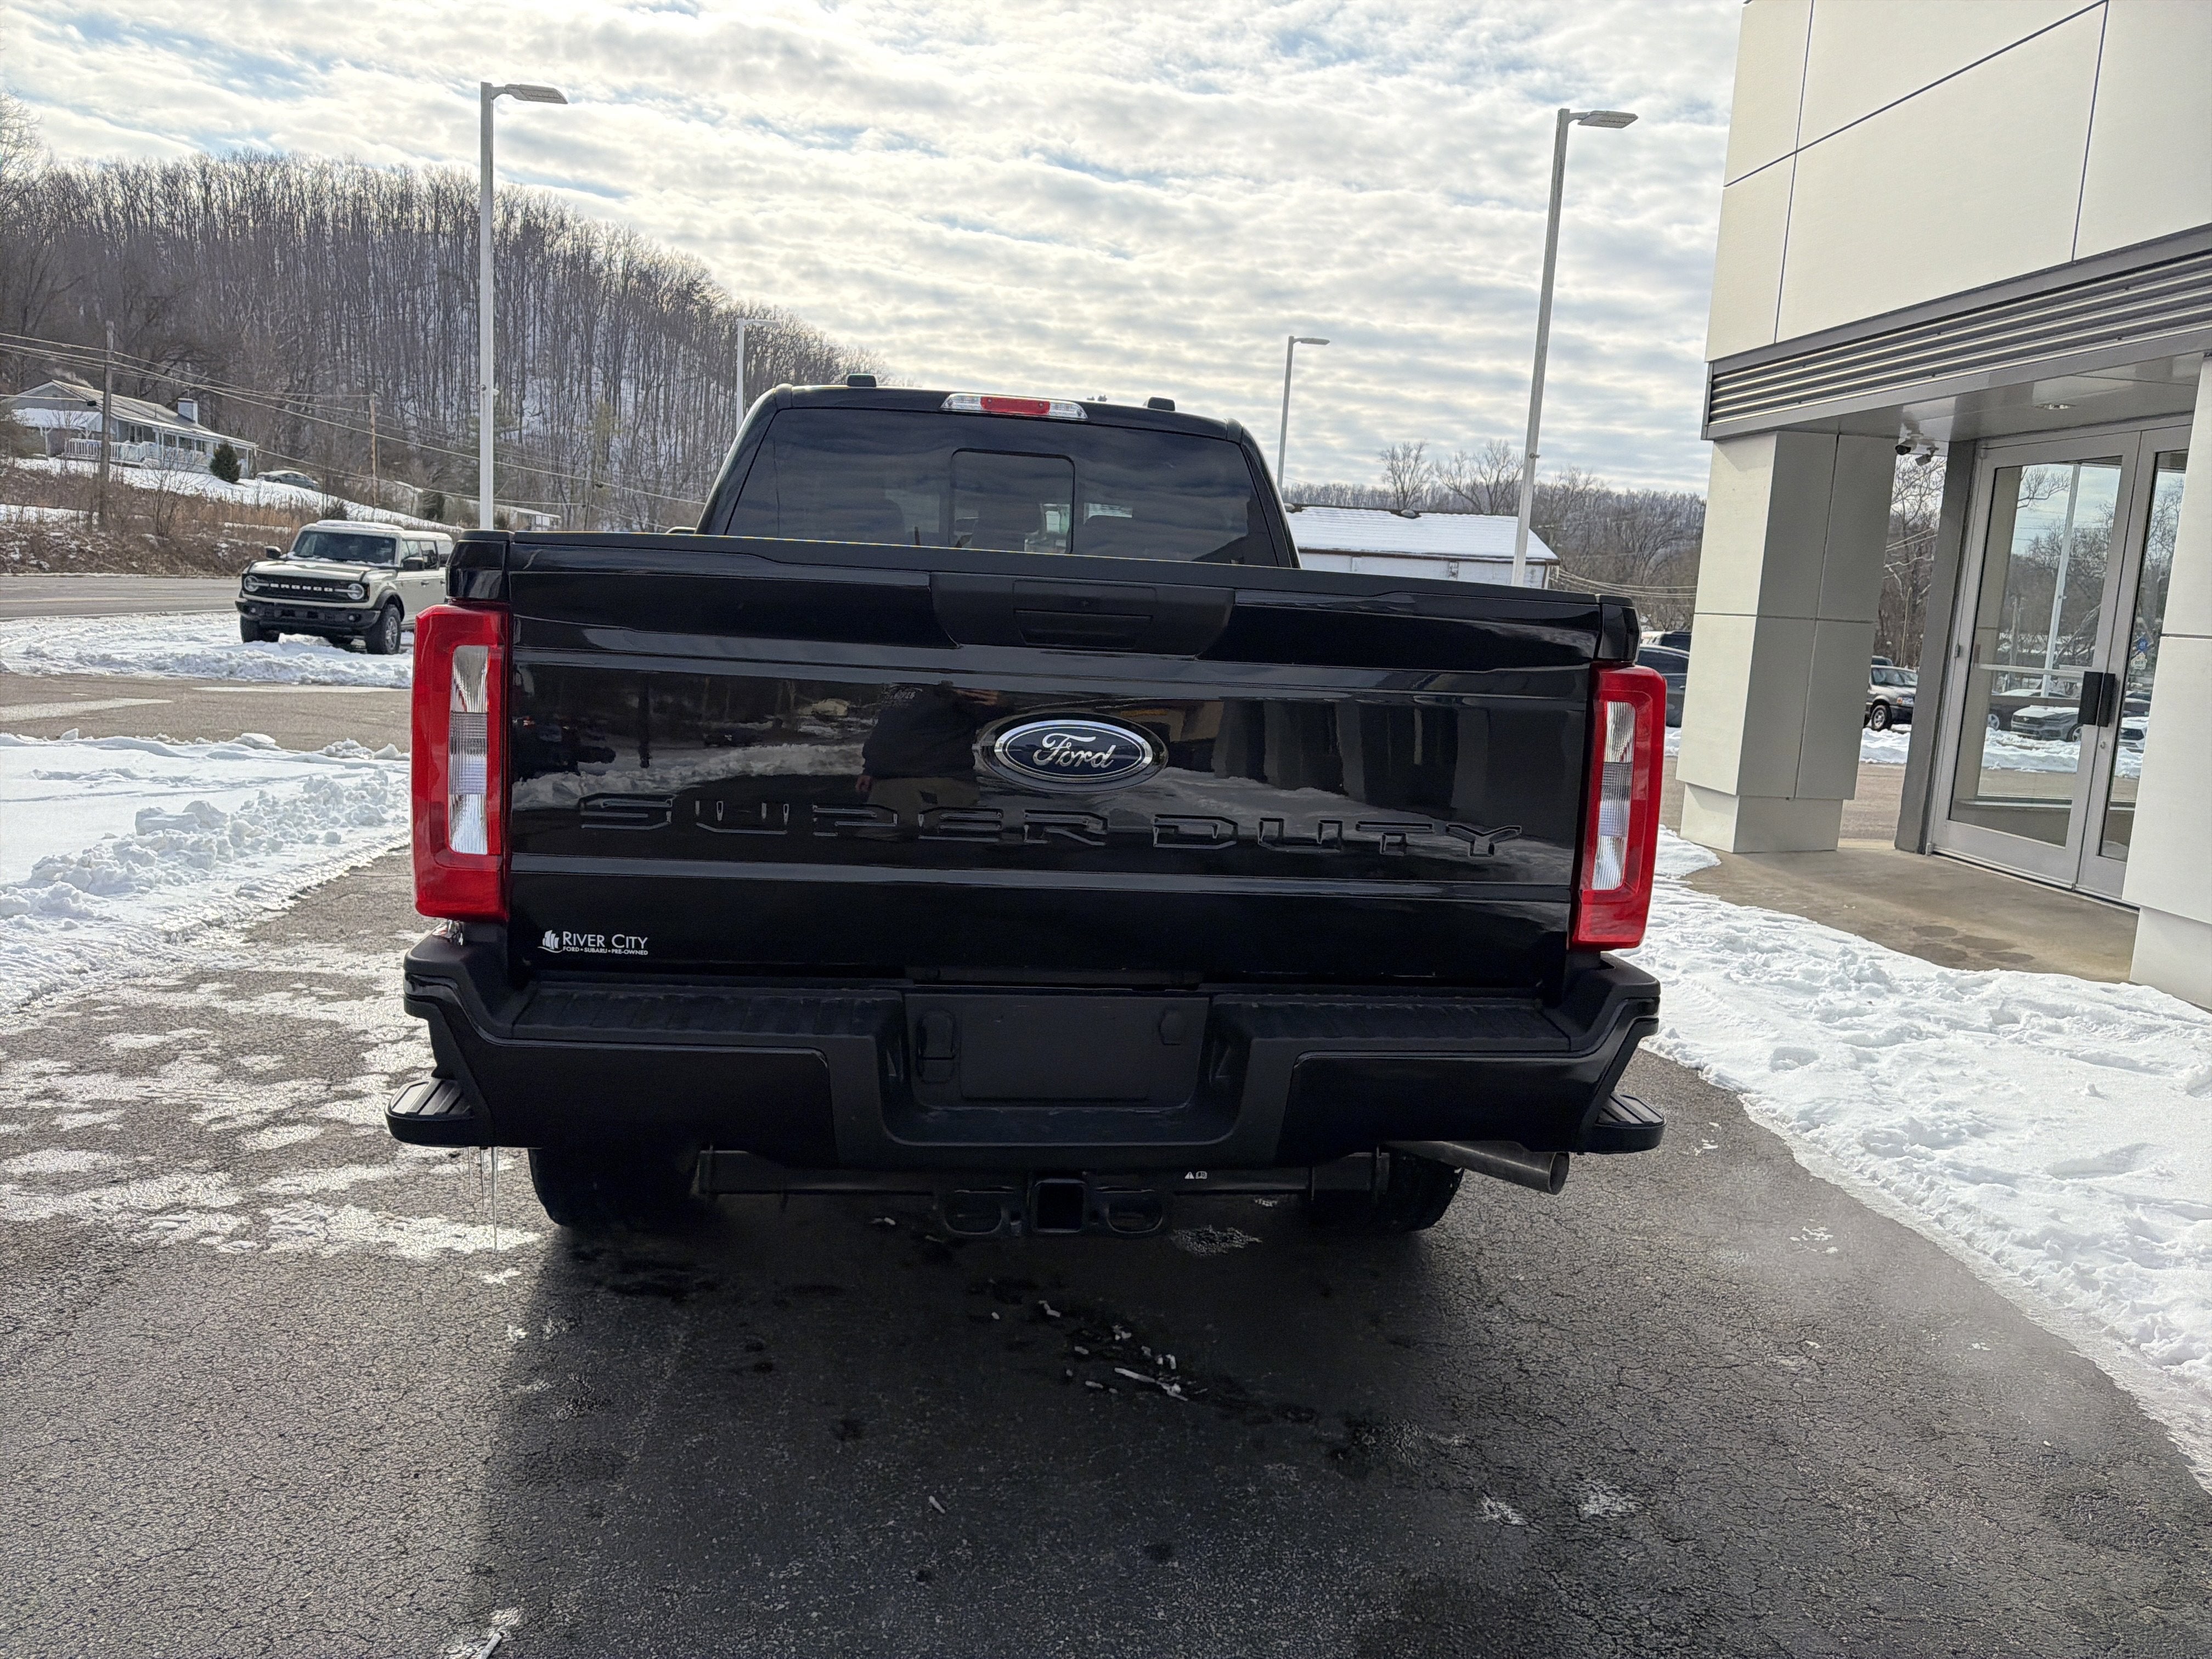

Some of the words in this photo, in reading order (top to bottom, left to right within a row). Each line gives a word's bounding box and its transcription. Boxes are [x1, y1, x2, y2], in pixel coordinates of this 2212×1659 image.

[270, 583, 333, 592] BRONCO
[1032, 732, 1116, 768] Ford
[579, 793, 1107, 847] SUPER
[1153, 814, 1521, 857] DUTY
[563, 931, 605, 947] RIVER
[611, 934, 648, 949] CITY
